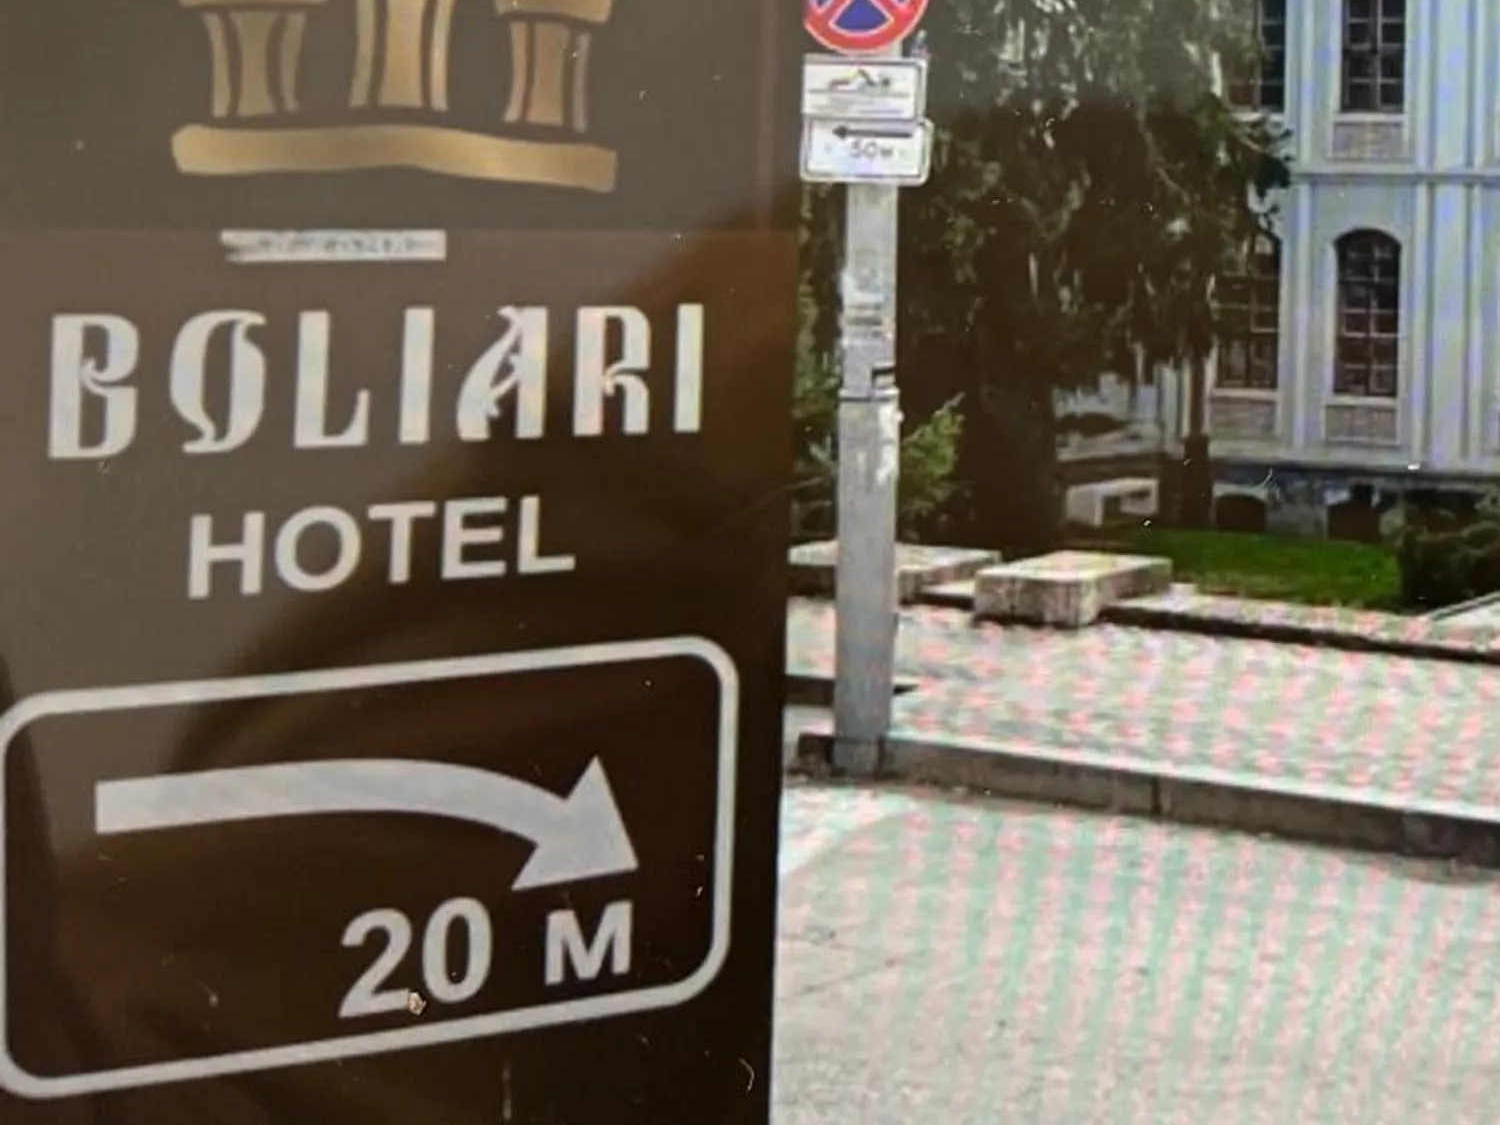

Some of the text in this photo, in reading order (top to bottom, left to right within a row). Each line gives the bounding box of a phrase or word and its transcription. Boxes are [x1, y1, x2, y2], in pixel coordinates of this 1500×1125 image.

[49, 304, 704, 459] BOLIARI
[189, 496, 576, 598] HOTEL
[340, 897, 493, 1019] 20
